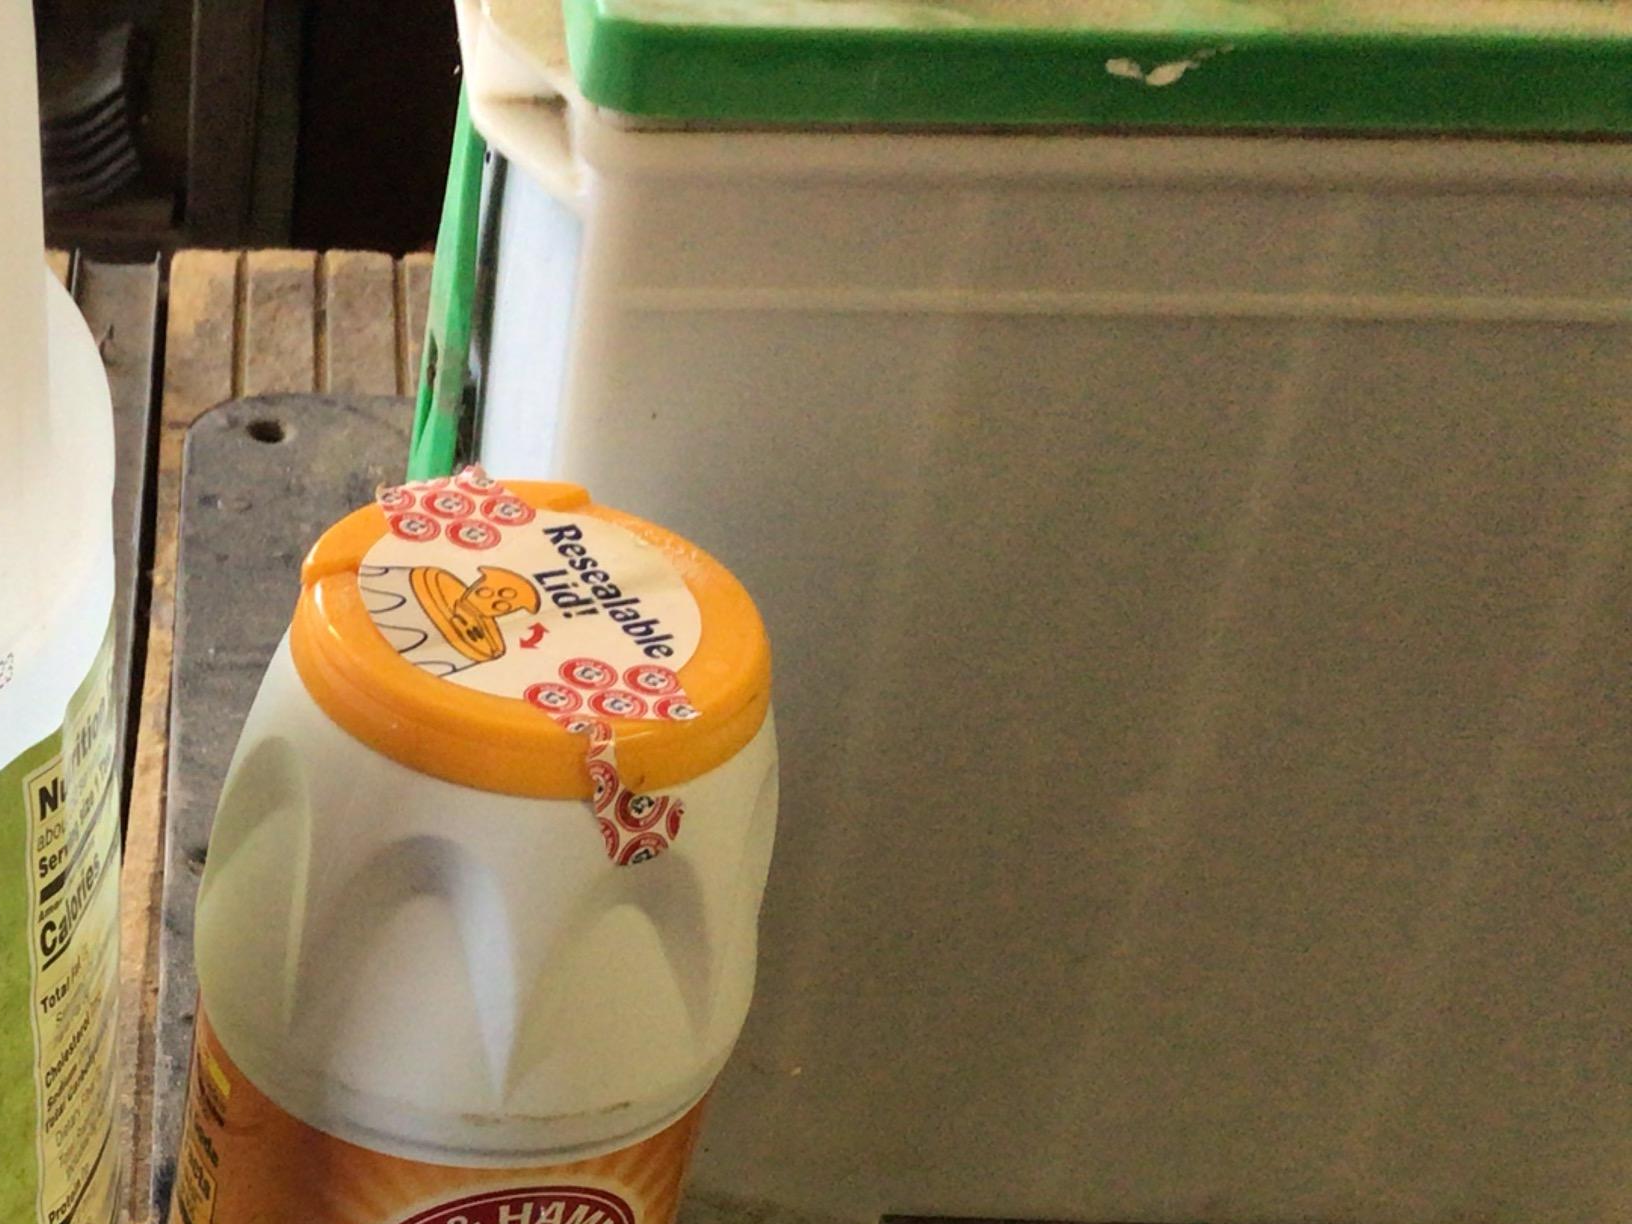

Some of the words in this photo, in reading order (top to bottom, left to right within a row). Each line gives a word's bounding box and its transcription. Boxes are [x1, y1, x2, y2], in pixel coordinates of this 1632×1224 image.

[533, 569, 599, 619] Lid!
[542, 524, 674, 659] Resealable
[40, 853, 102, 957] Calories
[40, 977, 70, 1014] Total
